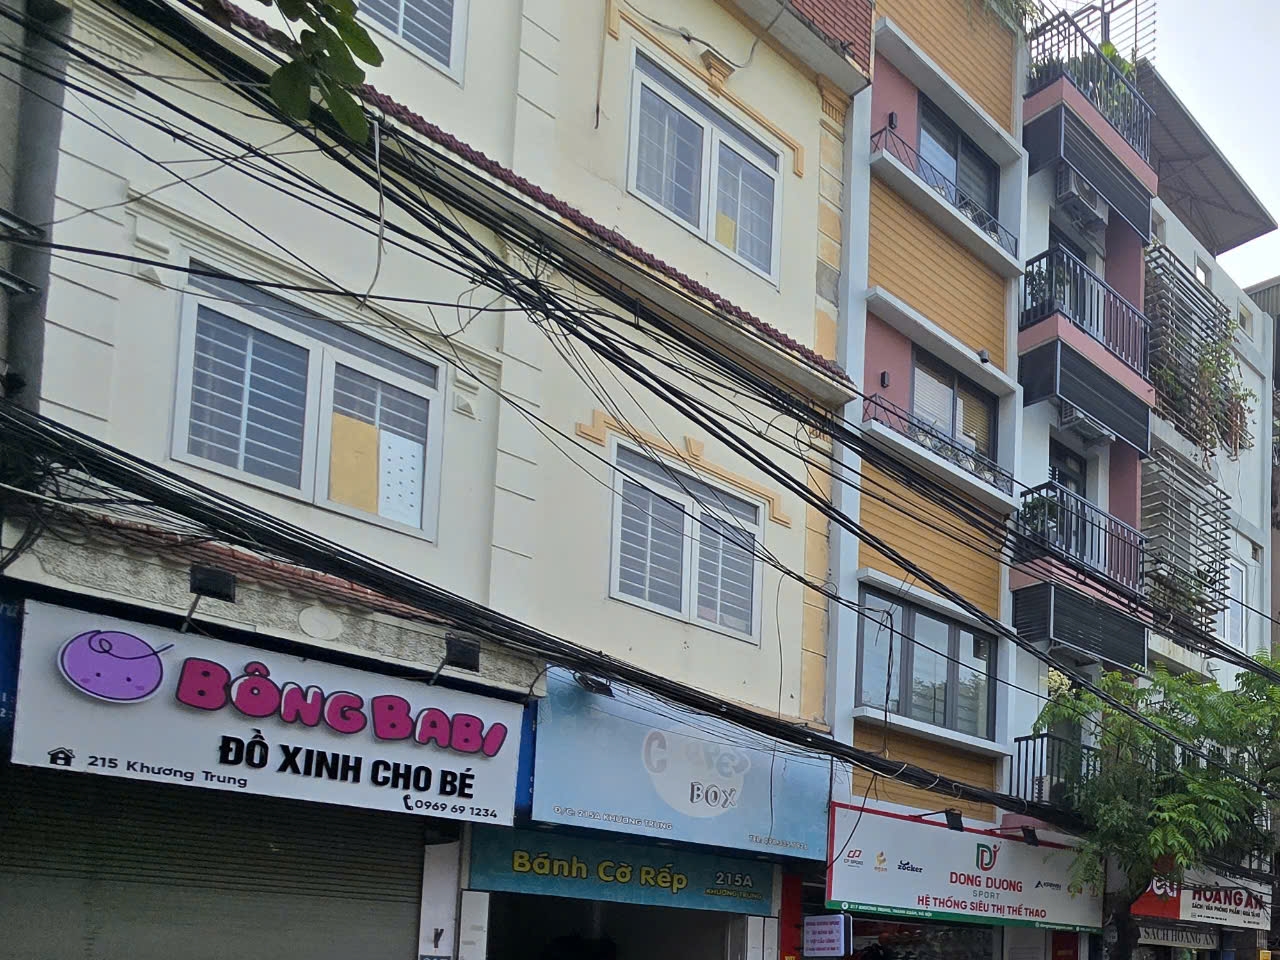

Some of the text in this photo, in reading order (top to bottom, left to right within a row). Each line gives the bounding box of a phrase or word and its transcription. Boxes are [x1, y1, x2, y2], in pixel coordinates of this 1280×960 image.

[176, 657, 508, 757] BÔNG BABI
[88, 756, 248, 788] 215 Khương Trung
[219, 728, 475, 799] ĐỒ XINH CHO BÉ
[690, 781, 737, 809] BOX
[415, 799, 497, 818] 0969 69 1234
[578, 810, 601, 821] 215A
[603, 813, 642, 826] KHƯƠNG
[644, 820, 673, 831] TRUNG
[512, 850, 688, 894] Bánh Cờ Rếp
[716, 872, 753, 888] 215A
[950, 872, 1022, 892] DONG DUONG
[972, 889, 1000, 899] SPORT
[917, 894, 930, 909] HỆ
[932, 895, 967, 909] THỐNG
[970, 901, 989, 913] SIÊU
[991, 903, 1005, 916] THỊ
[1024, 906, 1047, 919] THAO
[1203, 934, 1215, 945] AN
